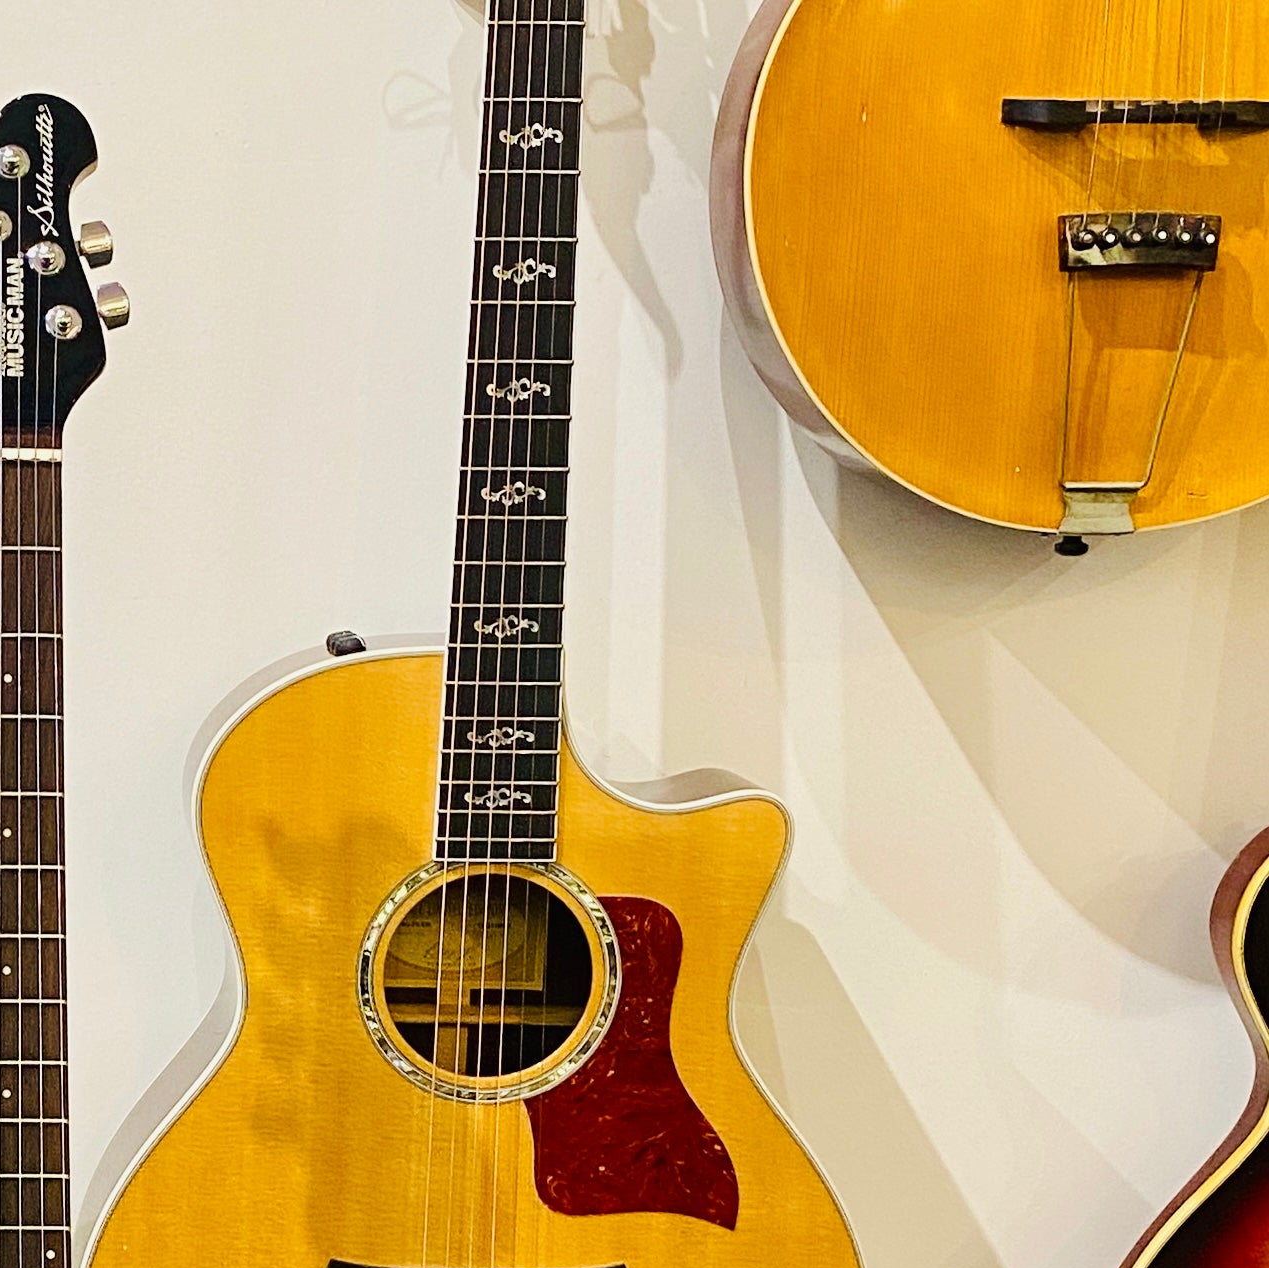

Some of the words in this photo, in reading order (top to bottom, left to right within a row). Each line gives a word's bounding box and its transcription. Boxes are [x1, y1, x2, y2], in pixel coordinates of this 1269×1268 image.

[27, 103, 60, 237] Silhouette
[7, 258, 24, 305] MAN
[7, 307, 24, 377] MUSIC
